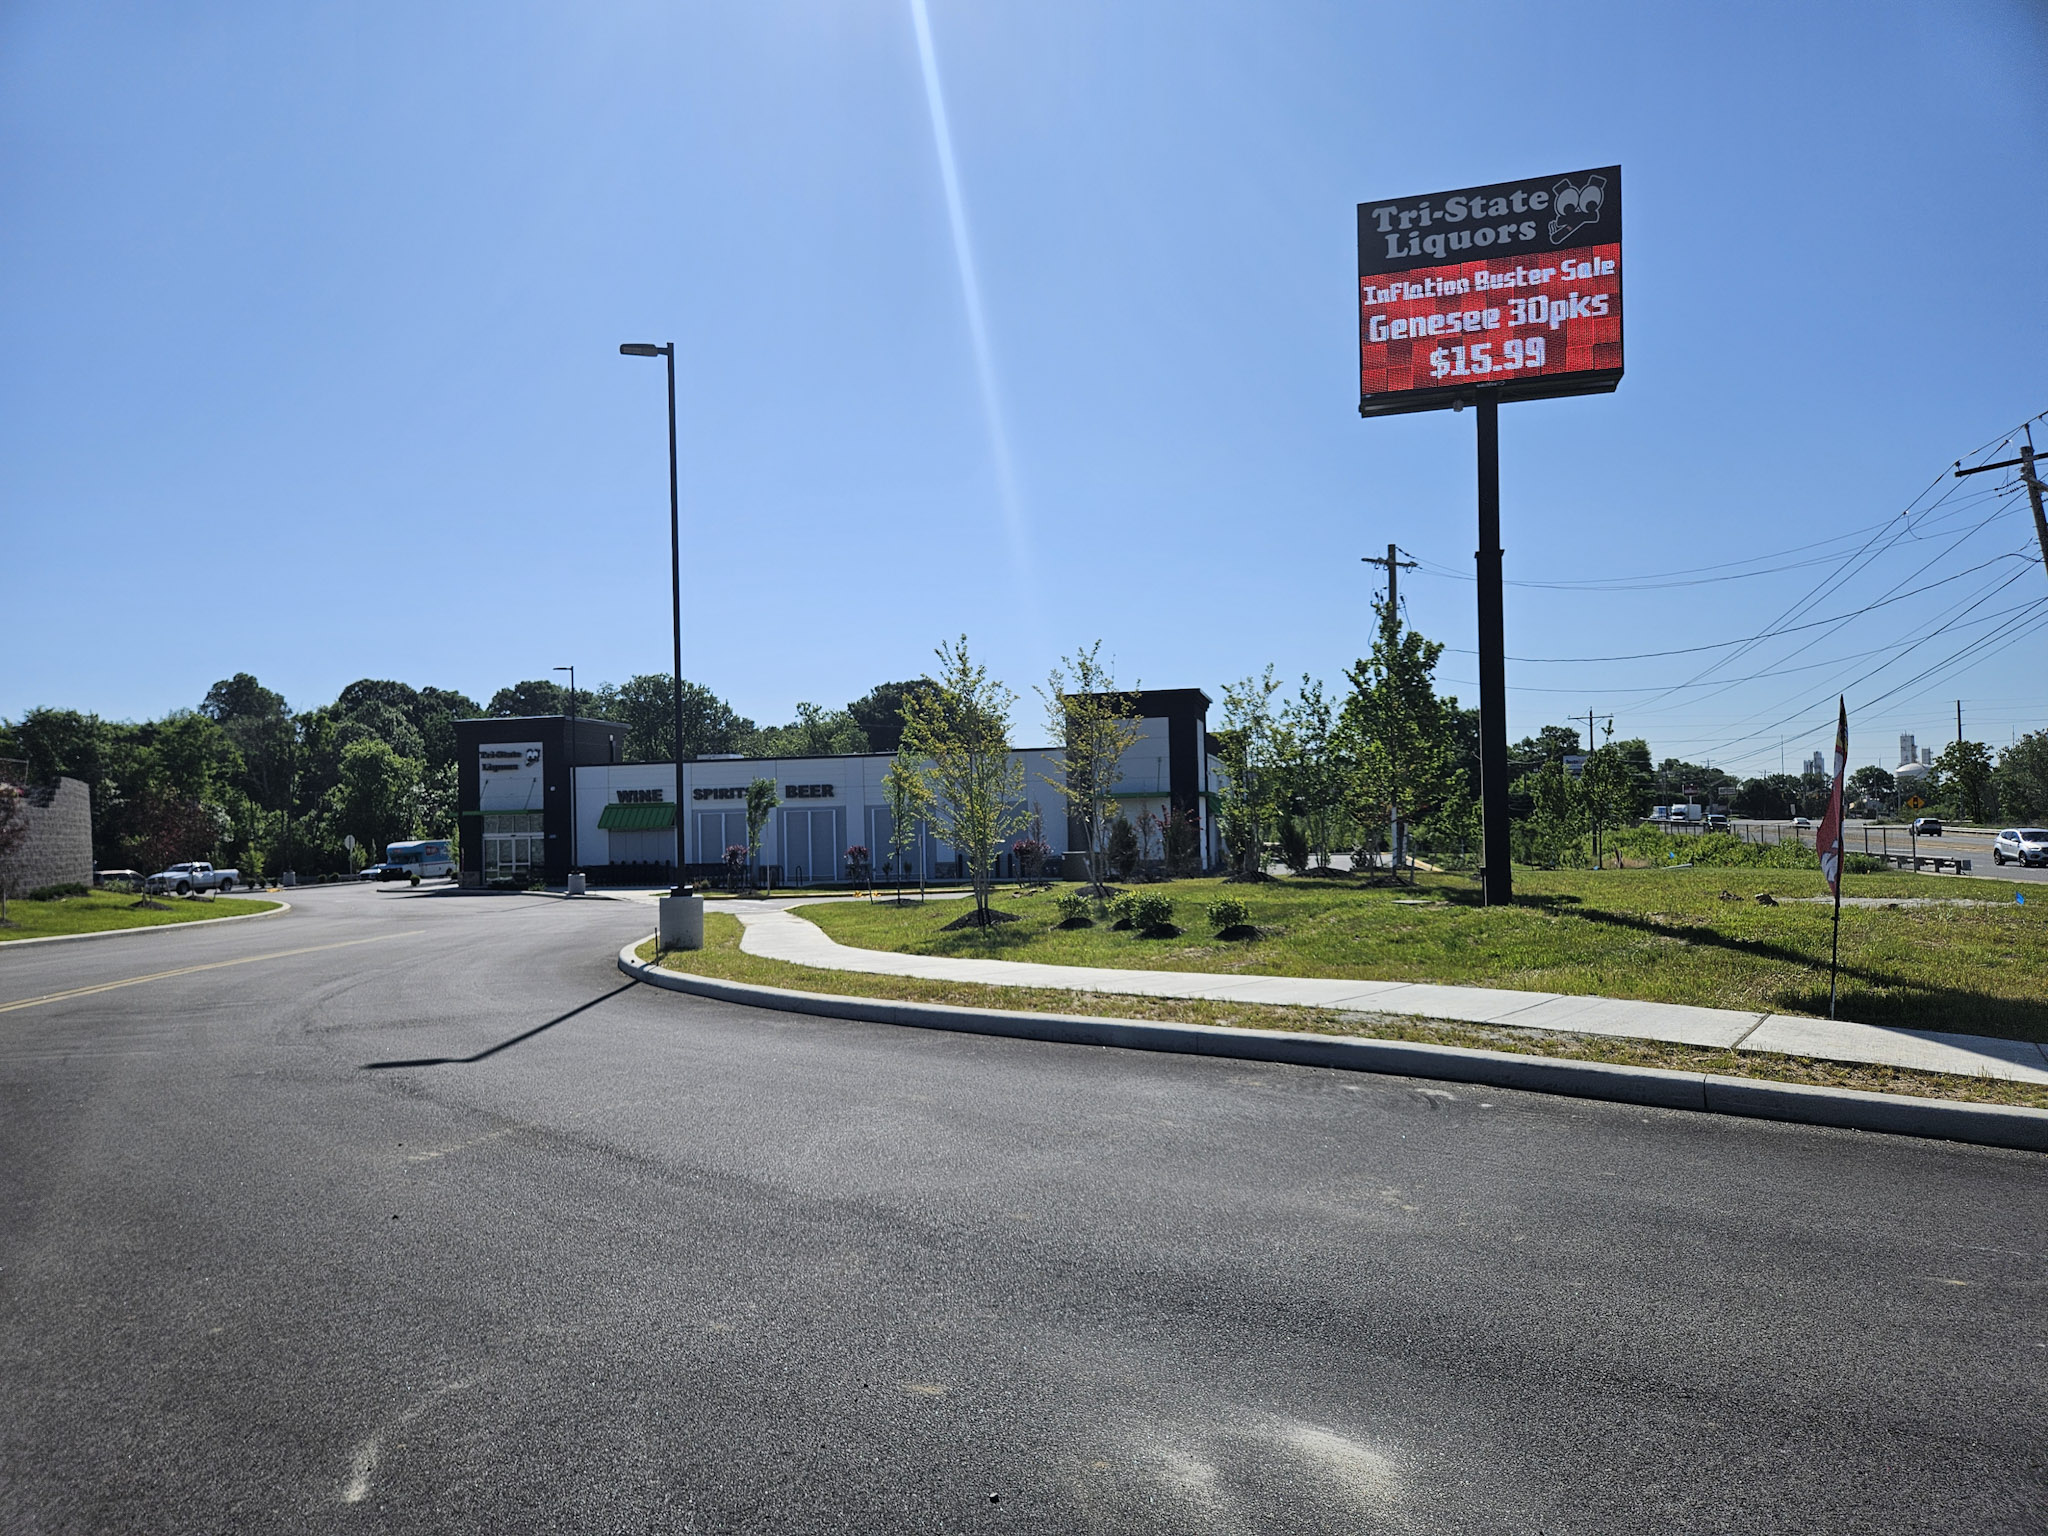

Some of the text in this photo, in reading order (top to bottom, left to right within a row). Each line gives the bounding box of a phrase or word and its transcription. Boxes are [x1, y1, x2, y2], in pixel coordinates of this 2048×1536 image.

[1372, 190, 1549, 232] Tri-State
[1385, 221, 1537, 259] Liquors
[1475, 265, 1556, 292] Buster
[1561, 256, 1615, 281] Sale
[1369, 292, 1609, 342] Genesee 30pks
[1430, 336, 1546, 379] $15.99
[616, 788, 663, 802] WINE
[785, 783, 835, 799] BEER
